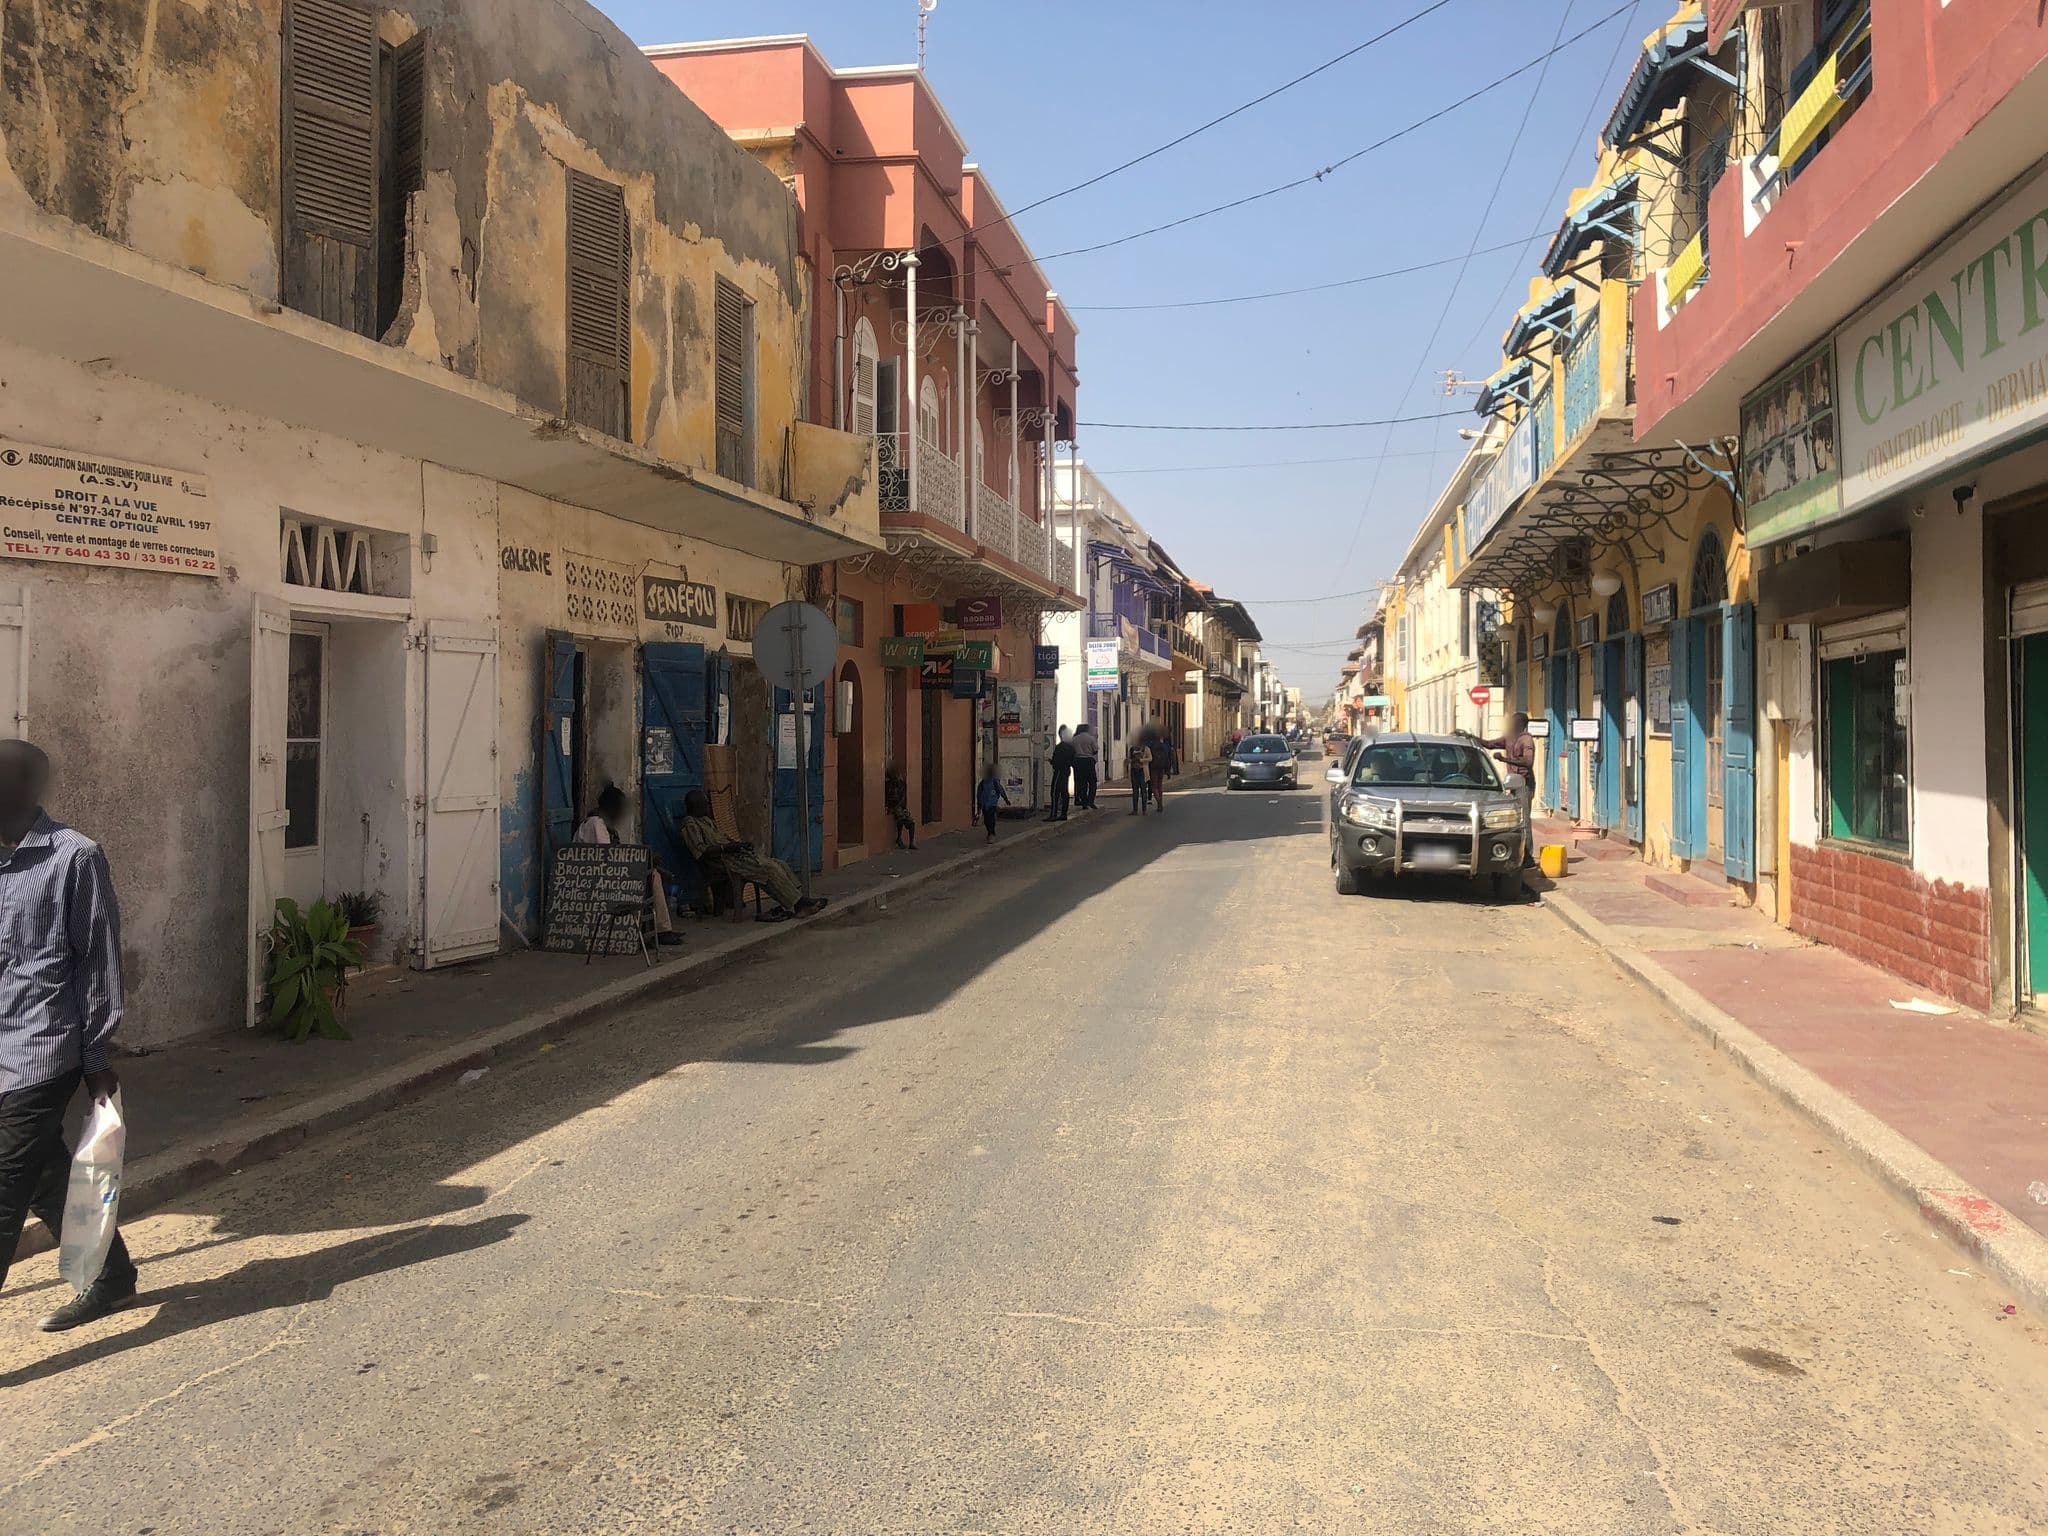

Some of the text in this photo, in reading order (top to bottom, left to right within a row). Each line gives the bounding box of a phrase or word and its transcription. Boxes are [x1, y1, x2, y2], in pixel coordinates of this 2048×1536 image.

[28, 452, 173, 487] ASSOCIATION SAINT-LOUISIENNE POUR LA VUE
[79, 474, 139, 492] (A.S.V)
[55, 488, 157, 512] DROIT A LA VUE
[0, 495, 65, 511] Récépissé
[125, 509, 138, 521] du
[140, 511, 153, 523] 02
[156, 514, 186, 528] AVRIL
[188, 519, 211, 531] 1997
[56, 513, 159, 534] CENTRE OPTIQUE
[3, 526, 215, 559] Conseil, vente et montage de verres correcteurs
[5, 542, 39, 554] TEL:
[43, 545, 59, 556] 77
[65, 547, 90, 558] 640
[95, 549, 110, 560] 43
[115, 551, 130, 561] 30
[141, 553, 156, 563] 33
[159, 555, 180, 566] 961
[184, 557, 199, 568] 62
[202, 560, 216, 570] 22
[501, 545, 552, 576] GALERIE
[905, 629, 936, 640] orange
[1037, 650, 1057, 664] tigo
[556, 845, 605, 862] GALERIE
